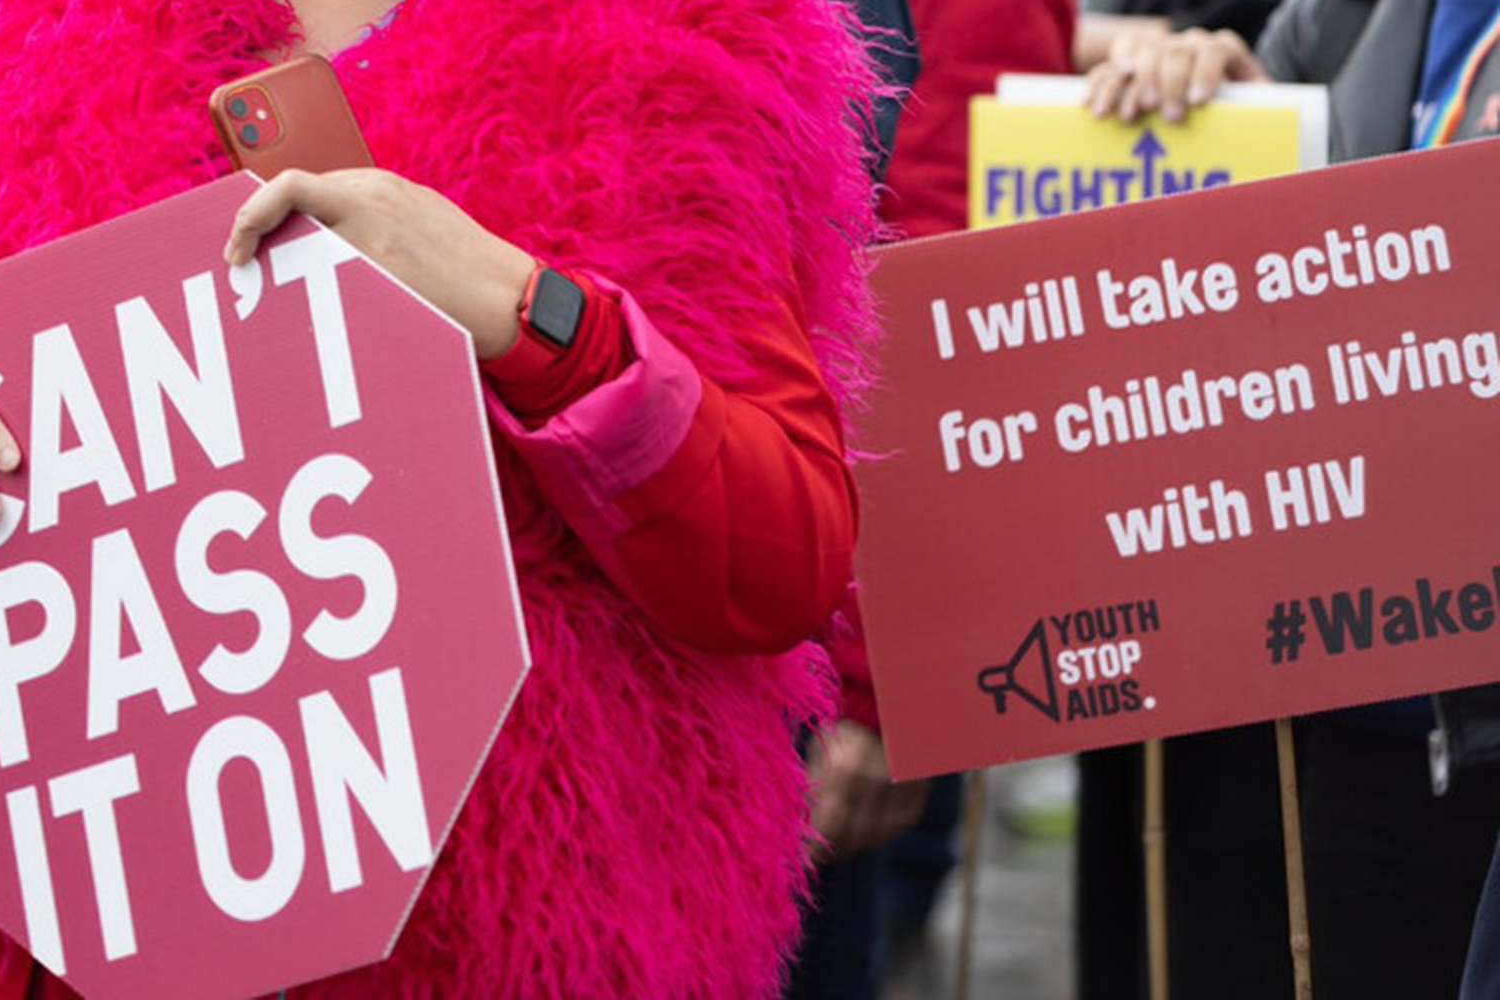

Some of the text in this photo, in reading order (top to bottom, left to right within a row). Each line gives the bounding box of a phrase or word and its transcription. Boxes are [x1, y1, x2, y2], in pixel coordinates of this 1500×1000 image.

[931, 224, 1451, 360] I will take action
[939, 331, 1500, 472] for children living
[1106, 455, 1365, 558] with HIV
[1050, 598, 1160, 646] YOUTH
[1057, 639, 1142, 685] STOP
[1265, 565, 1500, 665] #Wake
[5, 667, 432, 978] IT ON
